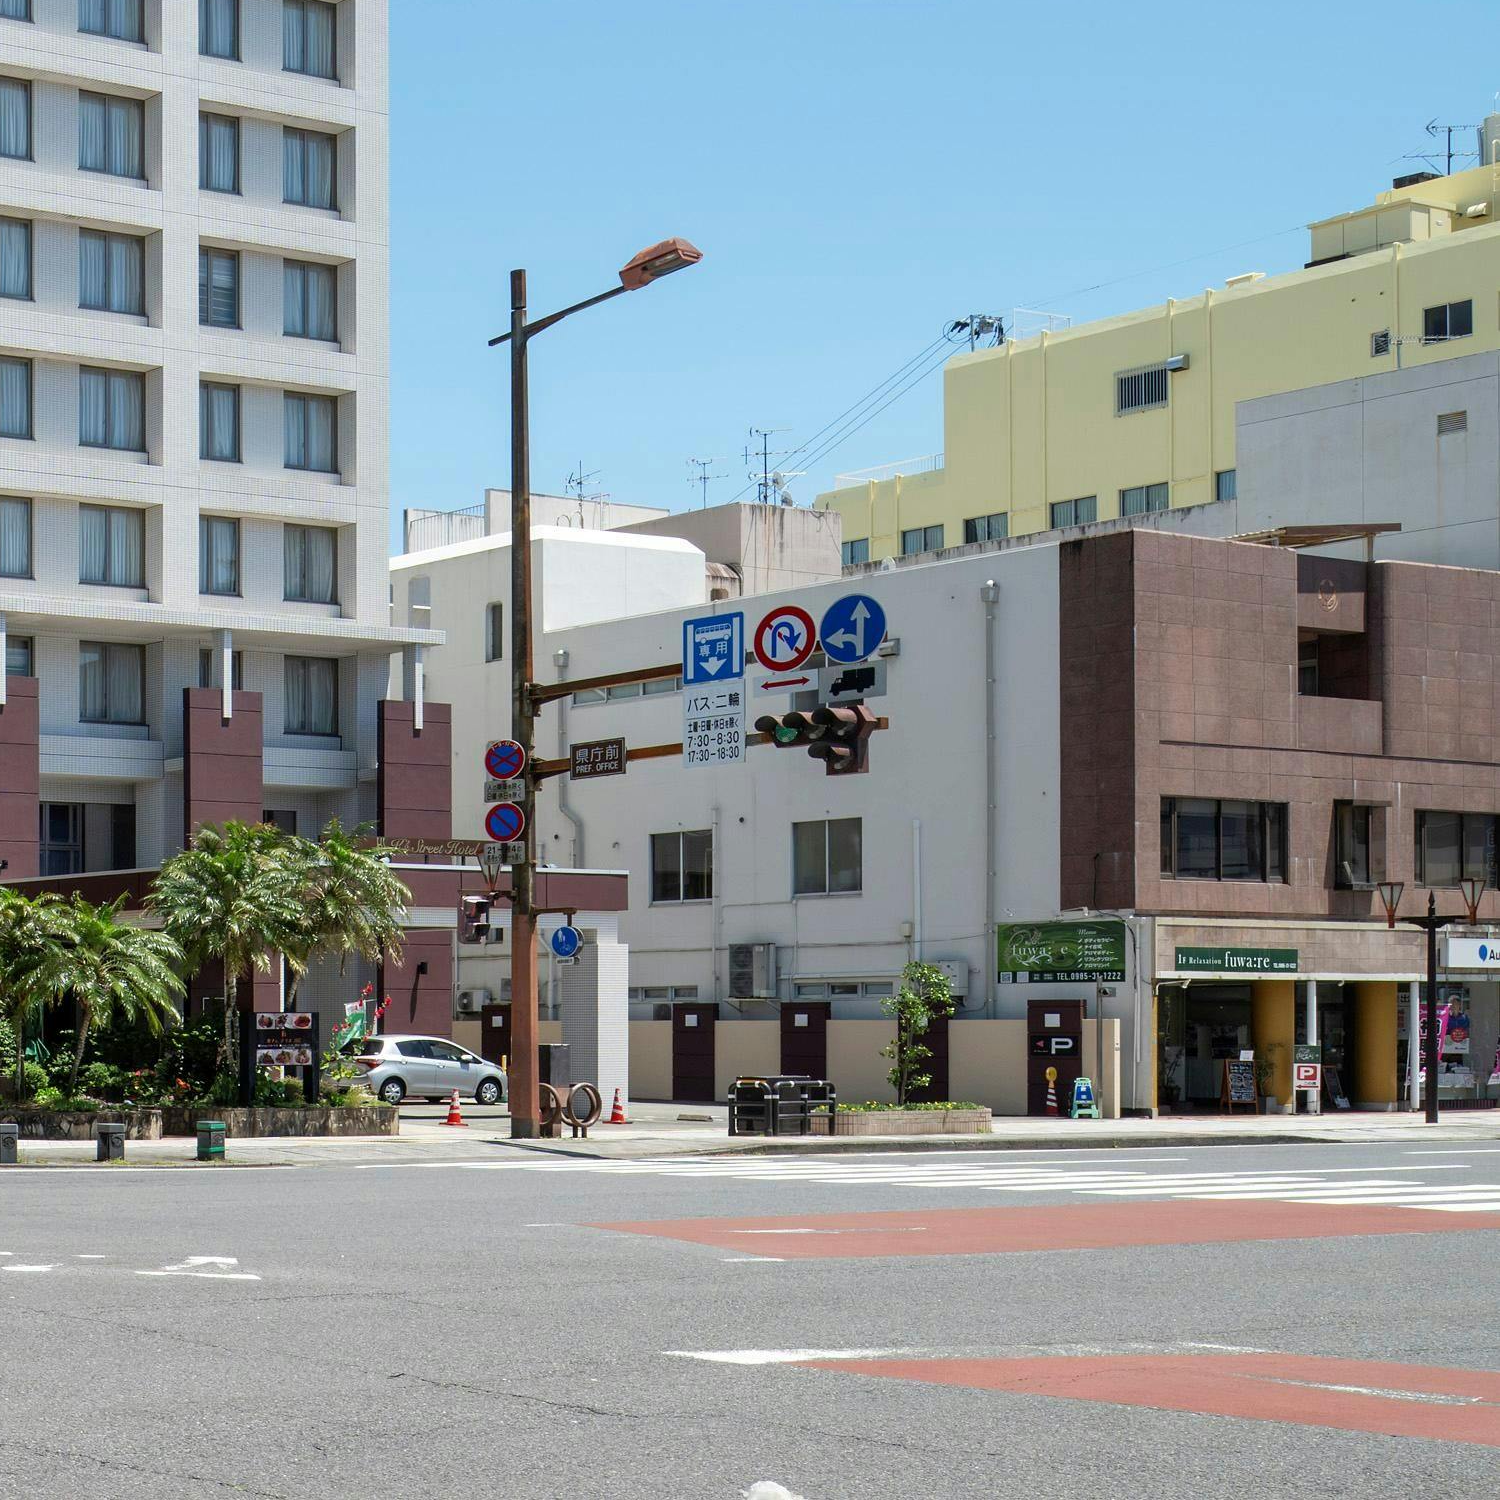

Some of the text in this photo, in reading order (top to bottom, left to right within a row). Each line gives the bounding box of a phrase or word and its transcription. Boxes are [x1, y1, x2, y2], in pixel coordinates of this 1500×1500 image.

[698, 641, 728, 657] 専用
[687, 692, 740, 713] バス・二輪
[576, 744, 619, 764] 県庁前
[575, 761, 619, 774] PREF. OFFICE
[412, 839, 444, 854] Street
[446, 841, 482, 856] Hotel
[1188, 956, 1222, 965] Relaxation
[1224, 951, 1270, 969] fuwa:re
[1051, 1037, 1073, 1055] P
[1299, 1067, 1315, 1080] P
